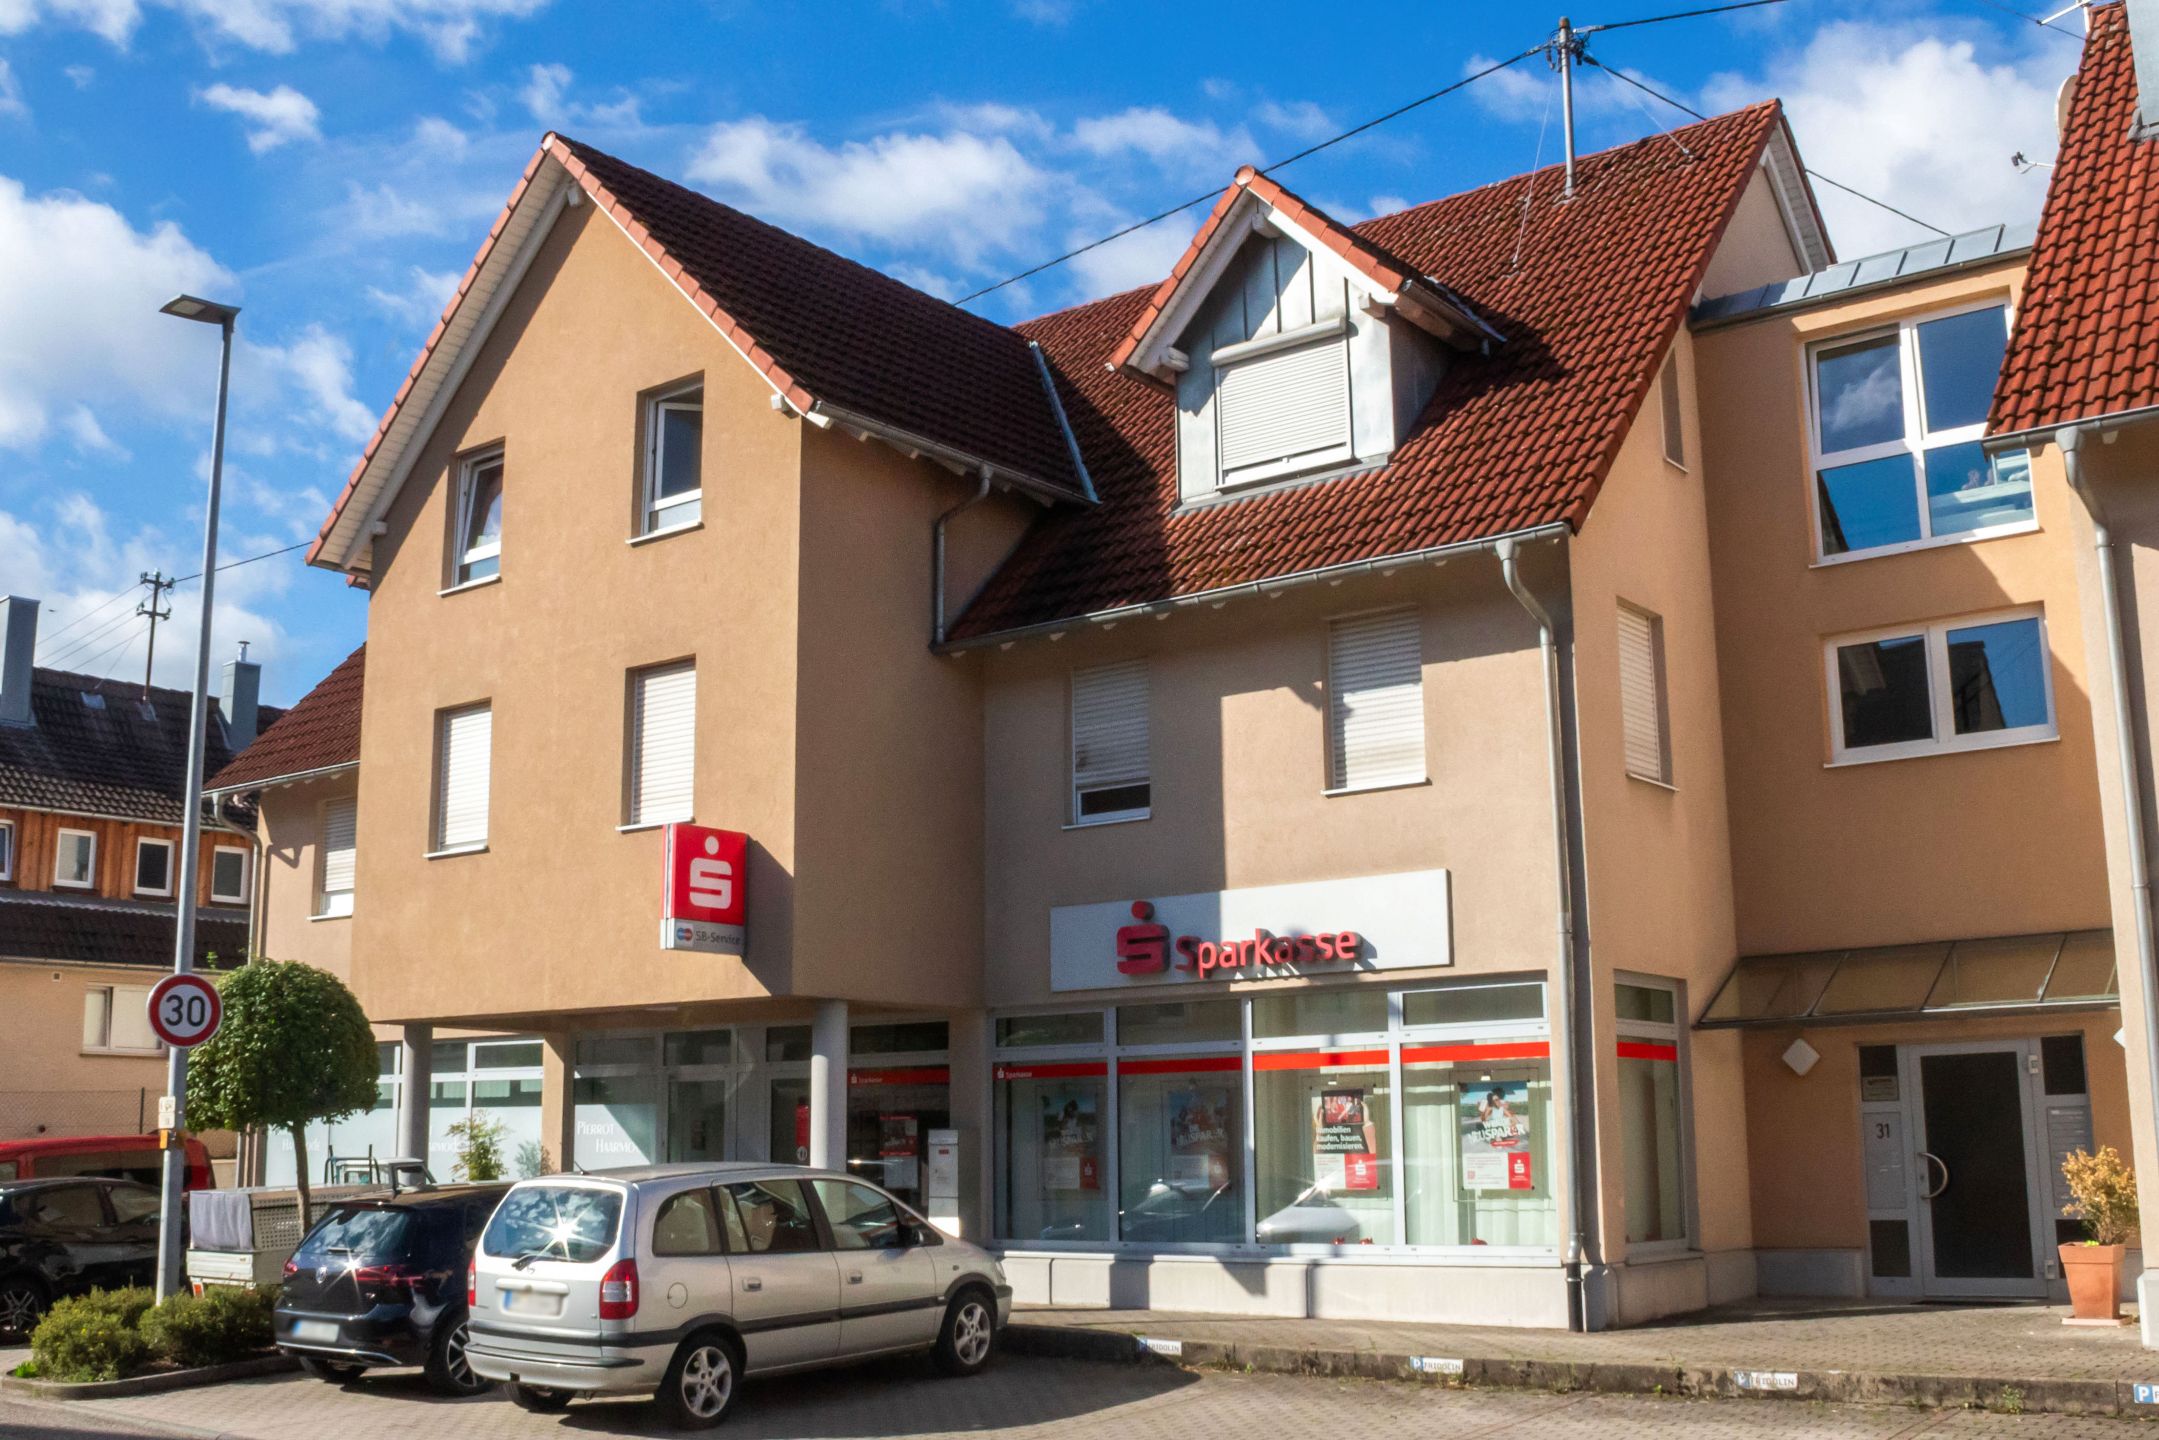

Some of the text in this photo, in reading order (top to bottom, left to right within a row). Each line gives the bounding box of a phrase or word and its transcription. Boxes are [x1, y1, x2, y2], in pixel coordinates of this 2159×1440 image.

[695, 929, 741, 945] SB-Service
[1175, 928, 1361, 979] Sparkasse
[165, 994, 206, 1027] 30
[1876, 1123, 1890, 1139] 31
[2138, 1386, 2150, 1401] P
